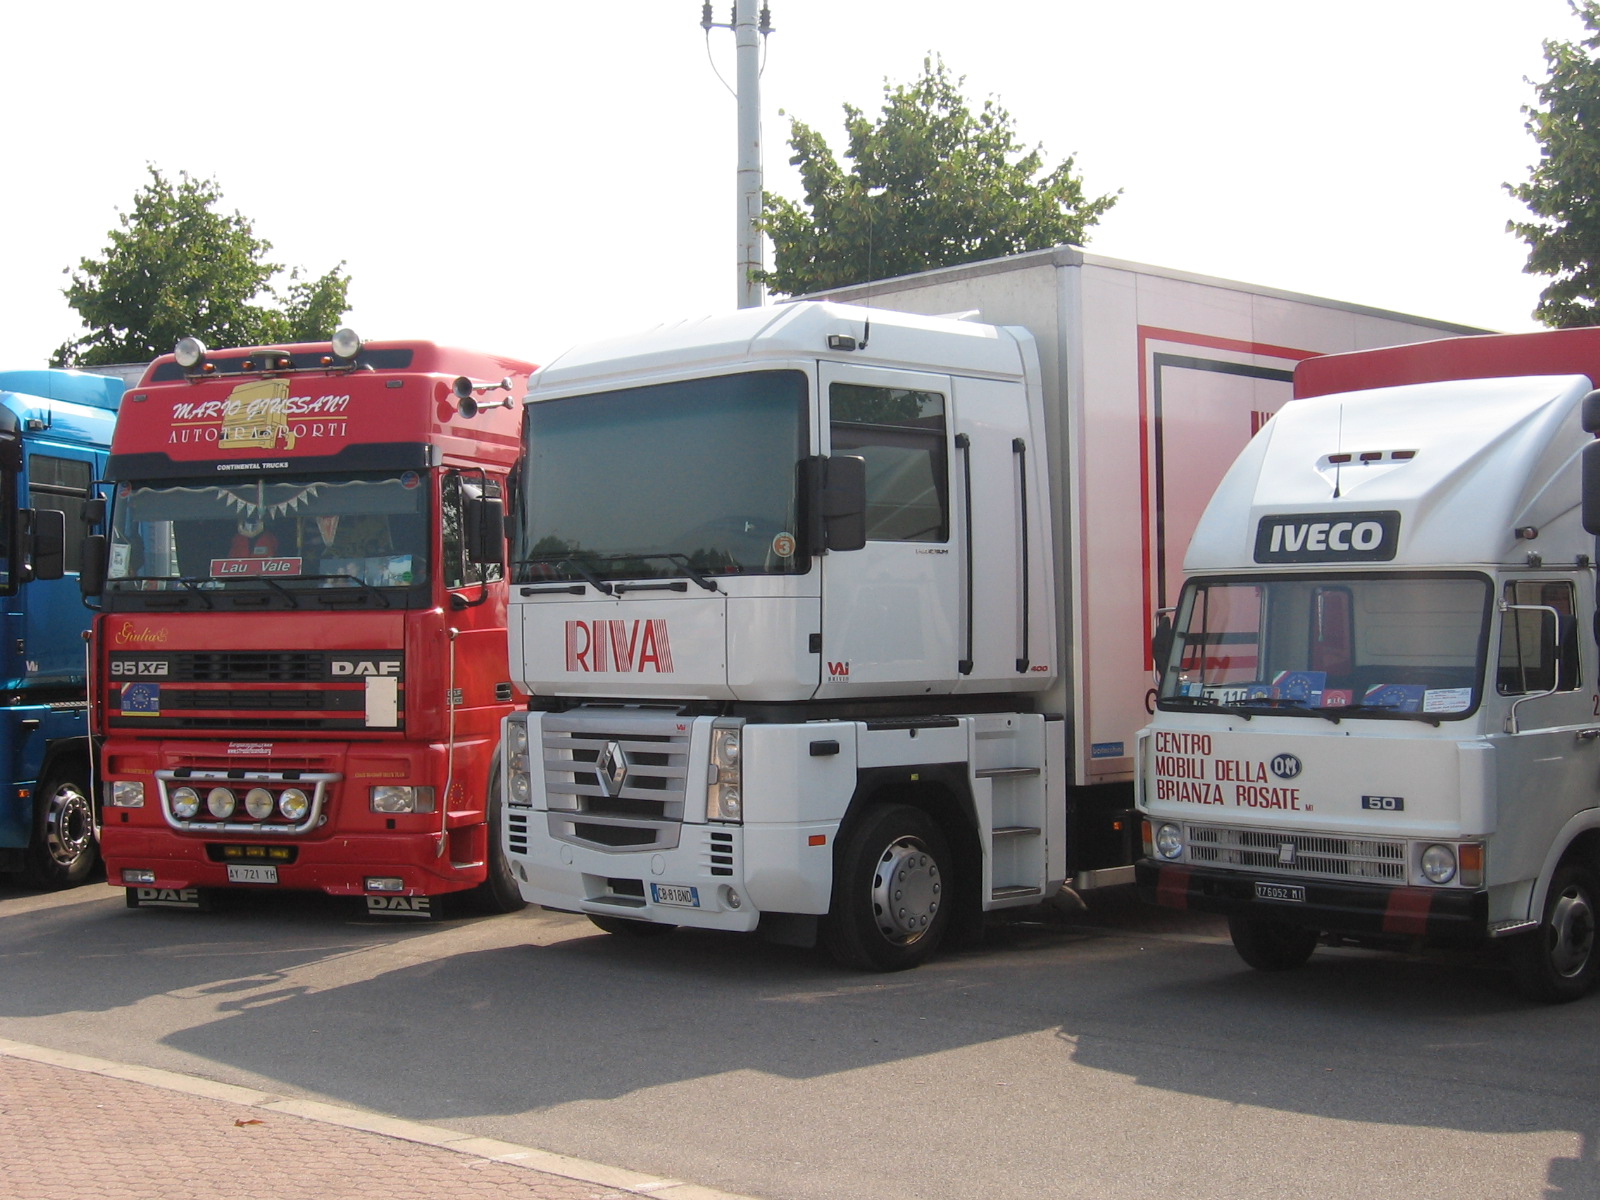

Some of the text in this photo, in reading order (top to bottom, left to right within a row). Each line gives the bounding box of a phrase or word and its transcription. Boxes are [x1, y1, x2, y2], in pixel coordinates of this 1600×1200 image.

[173, 394, 350, 421] MARIO GIUSSANI
[168, 422, 347, 444] AUTOTRASPORTI
[216, 461, 289, 471] CONTINENTAL TRUCKS
[1270, 521, 1383, 552] IVECO
[778, 541, 791, 555] 3
[221, 560, 291, 573] Lau Vale
[565, 619, 674, 673] RIVA
[331, 661, 401, 675] DAF
[1155, 731, 1212, 756] CENTRO
[1155, 755, 1268, 783] MOBILI DELLA
[1274, 757, 1297, 776] OM
[1157, 779, 1224, 806] BRIANZA
[1236, 785, 1300, 811] ROSATE
[1368, 797, 1396, 810] 50
[137, 888, 199, 900] DAF
[367, 896, 430, 909] DAF
